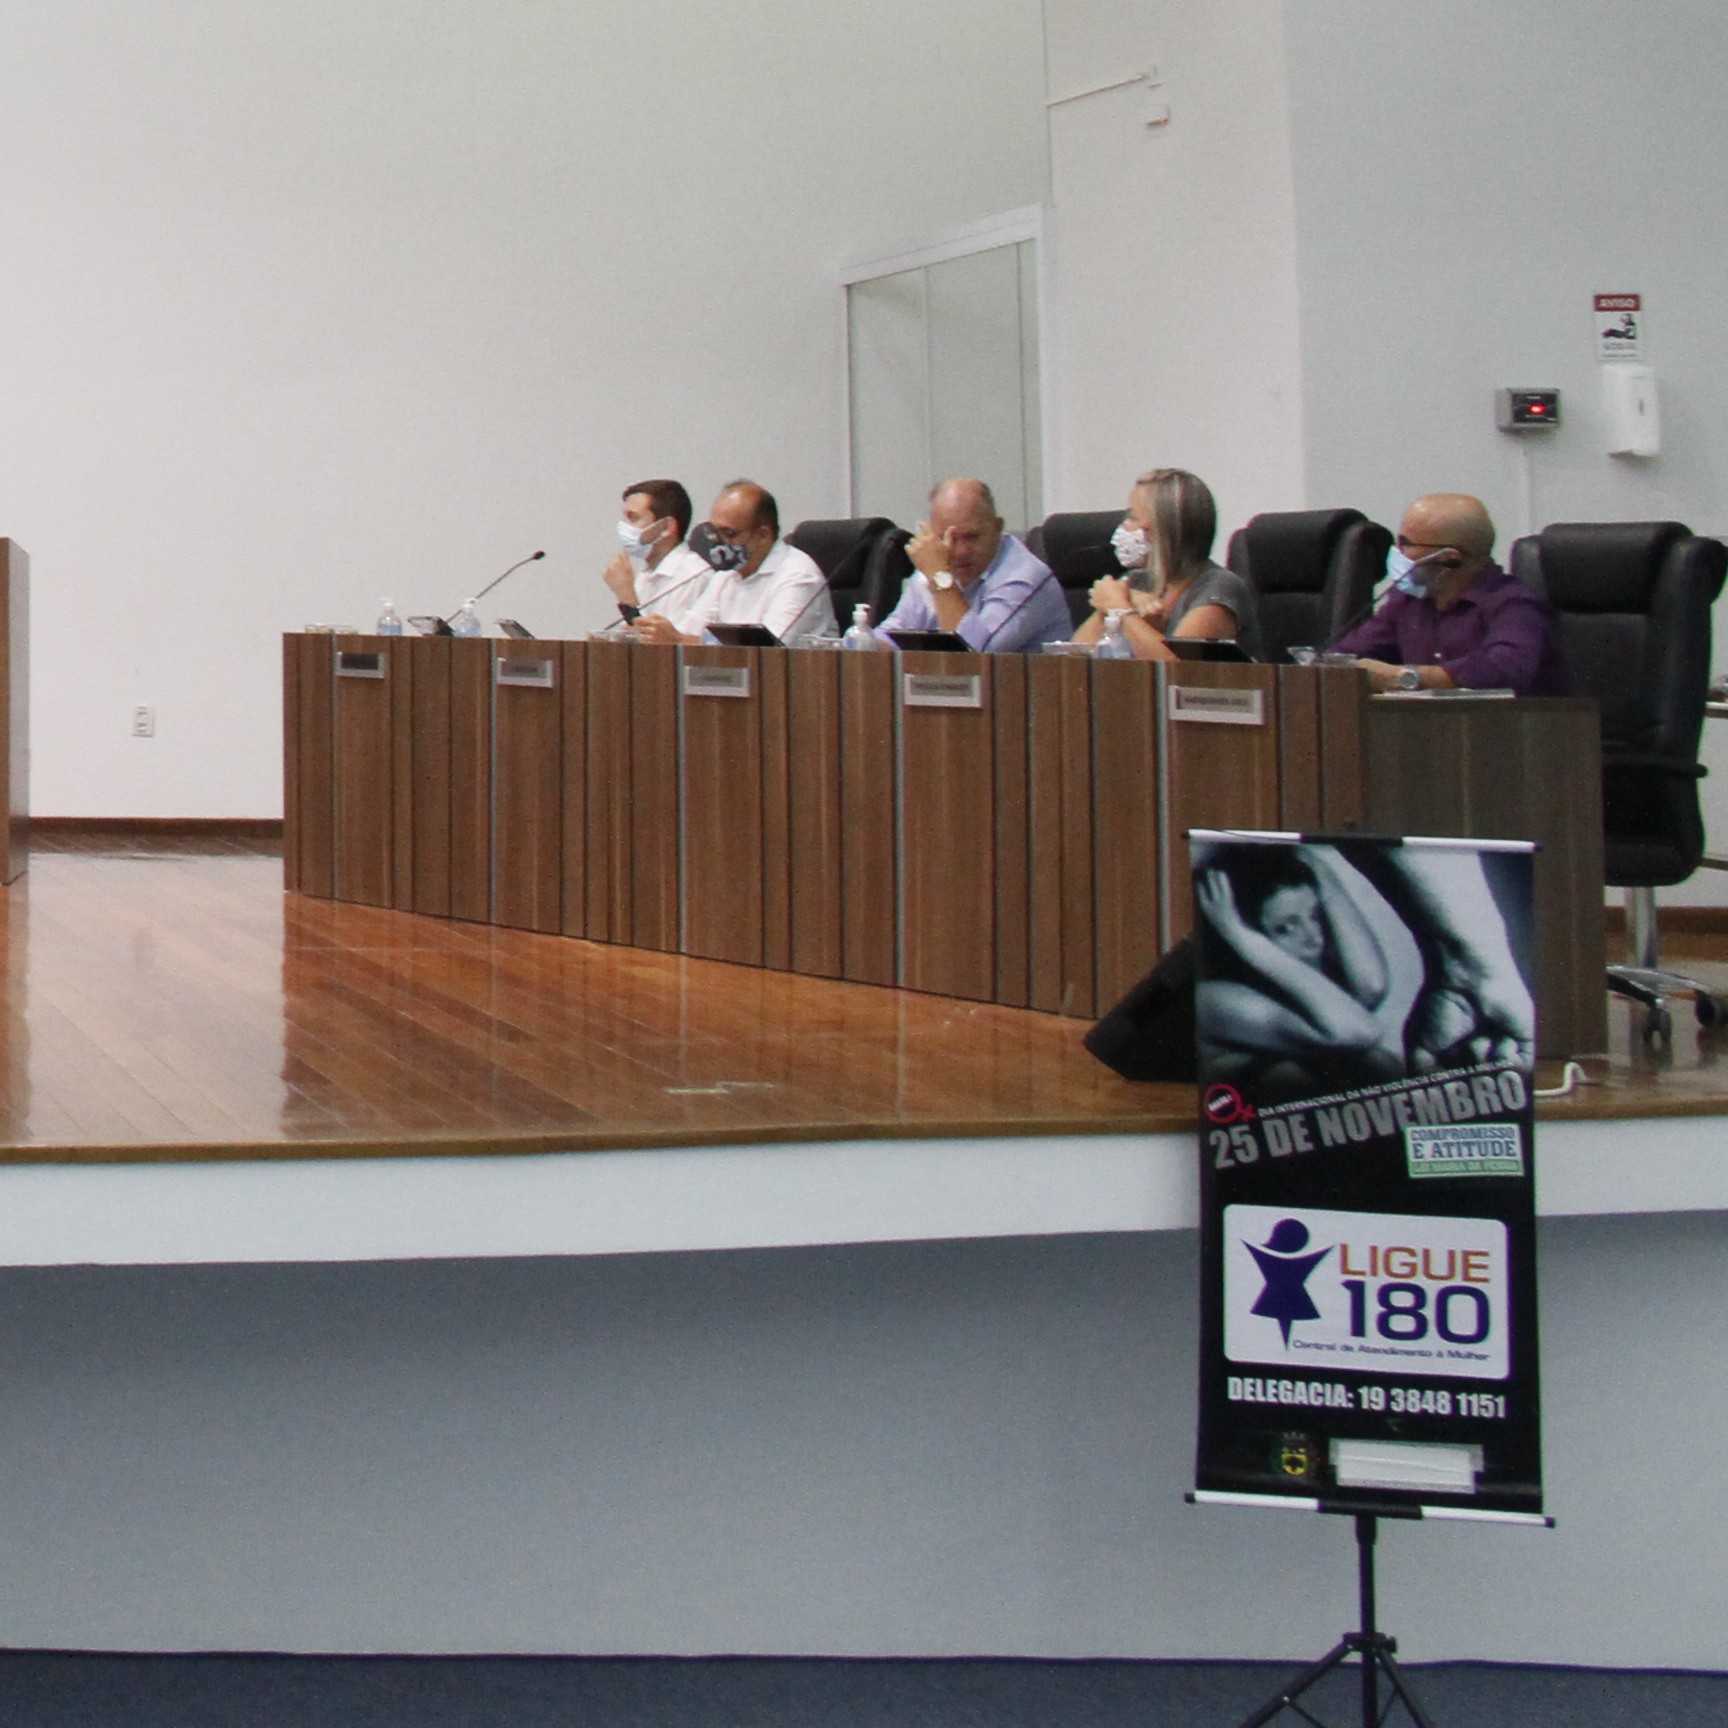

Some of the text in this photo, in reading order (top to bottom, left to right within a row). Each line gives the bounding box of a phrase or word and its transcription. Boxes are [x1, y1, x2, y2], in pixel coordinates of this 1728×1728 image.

[1209, 1070, 1527, 1169] 25 DE NOVEMBRO
[1413, 1141, 1516, 1158] E ATITUDE
[1340, 1244, 1490, 1282] LIGUE
[1341, 1280, 1490, 1343] 180
[1228, 1377, 1505, 1417] DELEGACIA: 19 3848 1151
